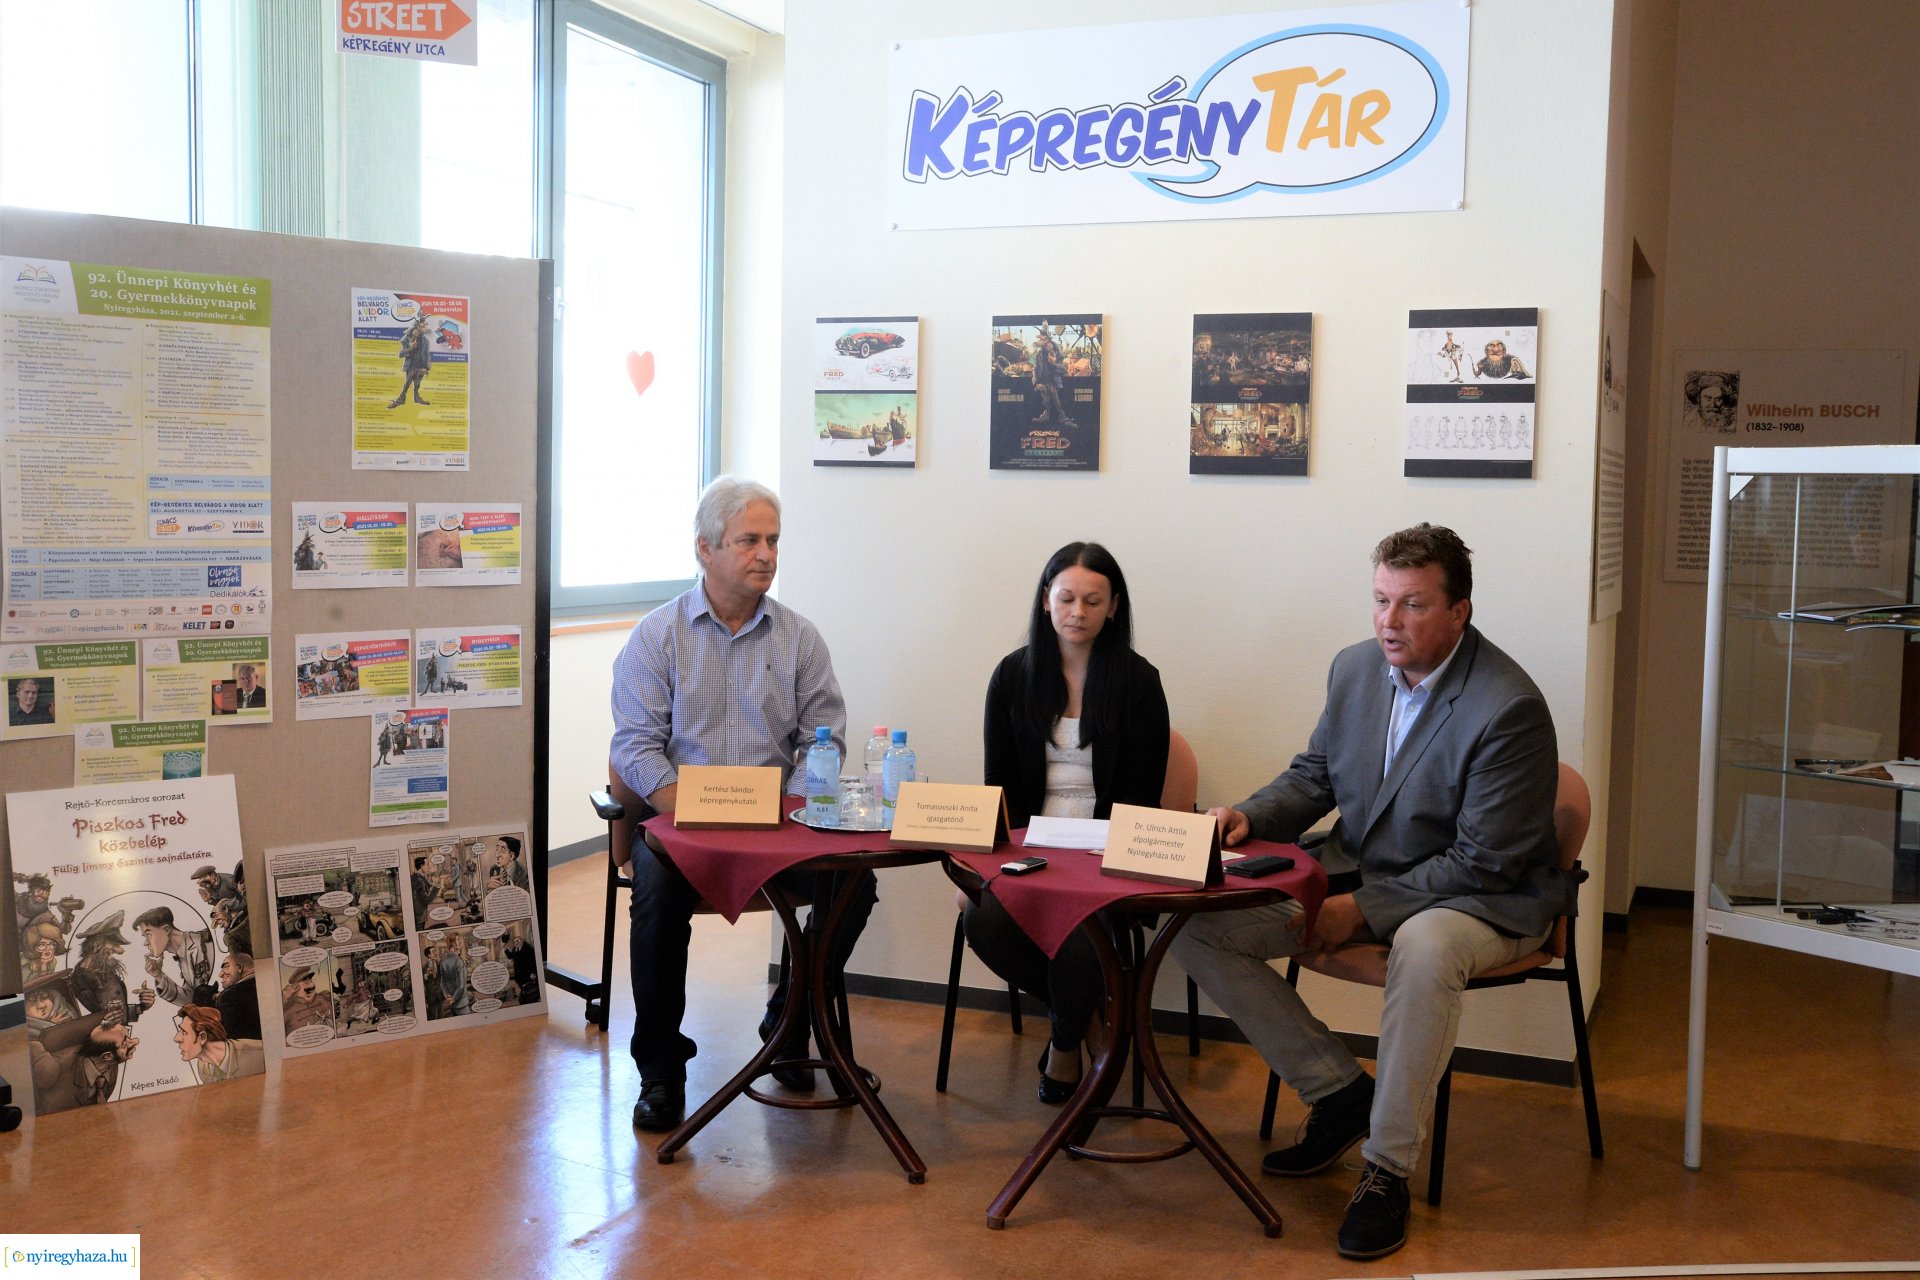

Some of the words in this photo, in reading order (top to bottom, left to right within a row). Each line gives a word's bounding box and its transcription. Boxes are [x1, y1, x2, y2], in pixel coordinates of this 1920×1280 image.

[347, 1, 446, 32] STREET
[342, 35, 411, 54] KÉPREGÉNY
[416, 43, 446, 56] UTCA
[88, 272, 111, 285] 92.
[116, 270, 169, 290] Ünnepi
[173, 277, 239, 294] Könyvhét
[242, 284, 257, 295] és
[90, 289, 112, 299] 20.
[117, 289, 257, 311] Gyermekkönyvnapok
[183, 310, 228, 320] szeptember
[363, 308, 389, 316] VIDOR
[1746, 403, 1814, 418] Wilhelm
[1820, 404, 1880, 418] BUSCH
[1020, 437, 1071, 449] FRED
[183, 621, 207, 630] KELET
[197, 641, 221, 649] Ünnepi
[223, 640, 253, 648] Könyvhét
[57, 646, 84, 655] Ünnepi
[85, 646, 119, 654] Könyvhét
[197, 647, 262, 656] Gyermekkönyvnapok
[57, 652, 128, 662] Gyermekkönyvnapok
[131, 725, 156, 733] Ünnepi
[158, 723, 190, 731] Könyvhét
[131, 730, 199, 740] Gyermekkönyvnapok
[703, 785, 729, 793] Kertész
[730, 785, 755, 793] Sándor
[152, 793, 186, 801] sorozat
[699, 796, 758, 806] képregénykutató
[916, 802, 959, 811] Tomasovszki
[960, 804, 978, 812] Anita
[72, 816, 145, 838] Piszkos
[149, 810, 188, 830] Fred
[926, 815, 964, 824] igazgatónő
[1134, 822, 1145, 831] Dr.
[1147, 822, 1167, 834] Ulrich
[1168, 825, 1187, 836] Attila
[99, 835, 167, 853] közbelép
[1132, 836, 1185, 849] alpolgármester
[1127, 847, 1169, 860] Nyíregyháza
[1170, 853, 1186, 862] MJV
[52, 862, 80, 876] Fülig
[83, 860, 113, 873] Jimmy
[116, 856, 154, 867] őszinte
[156, 850, 212, 863] sajnálatára
[131, 1082, 155, 1091] Képes
[156, 1075, 179, 1086] Kiadó
